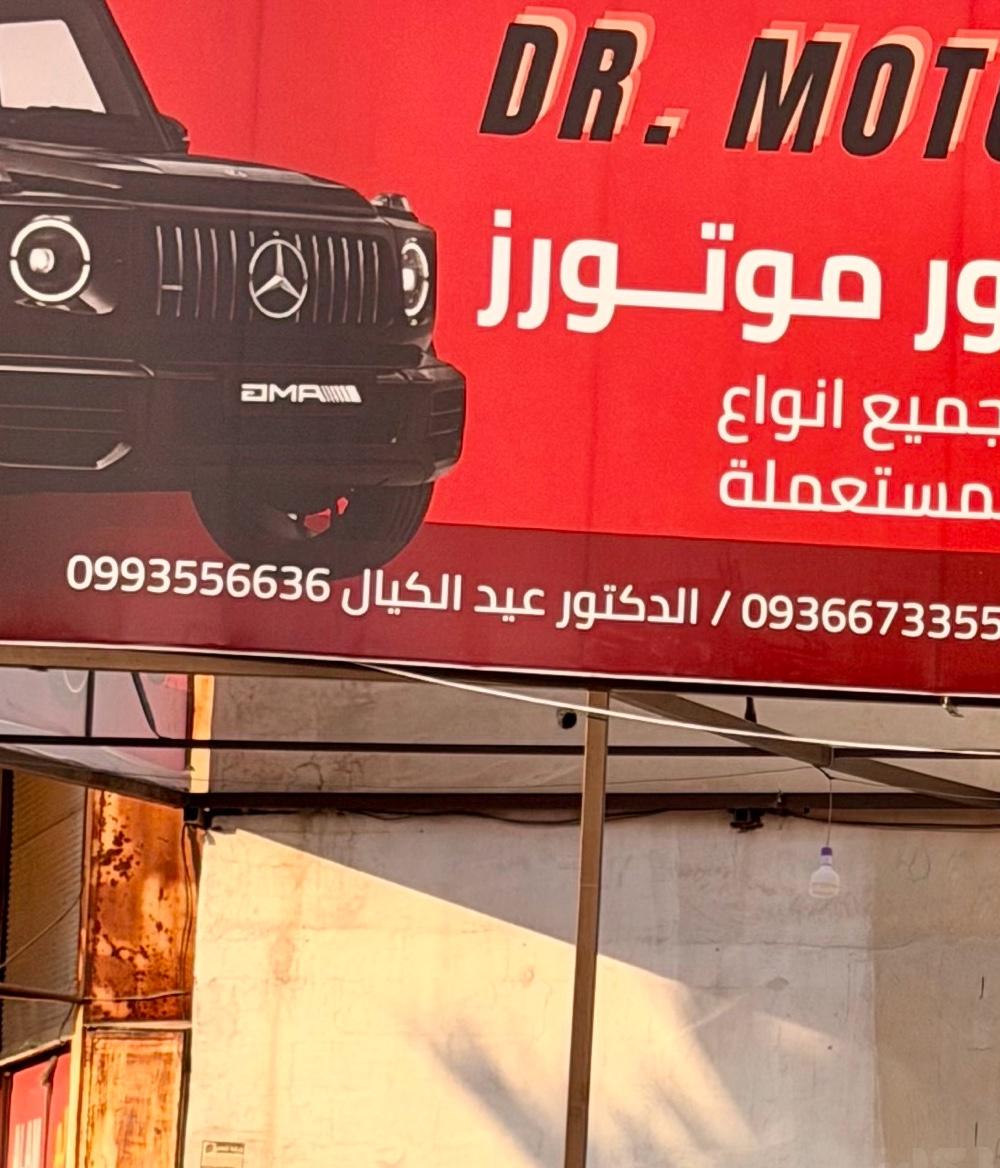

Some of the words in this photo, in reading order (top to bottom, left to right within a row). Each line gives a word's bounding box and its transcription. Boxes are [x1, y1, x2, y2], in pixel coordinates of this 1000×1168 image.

[478, 9, 688, 146] DR.
[476, 208, 882, 344] موتورز
[717, 374, 844, 444] انواع
[66, 554, 331, 603] 0993556636
[341, 568, 462, 616] الكيال
[473, 584, 546, 623] عيد
[555, 584, 699, 630] الدكتور
[711, 590, 732, 626] /
